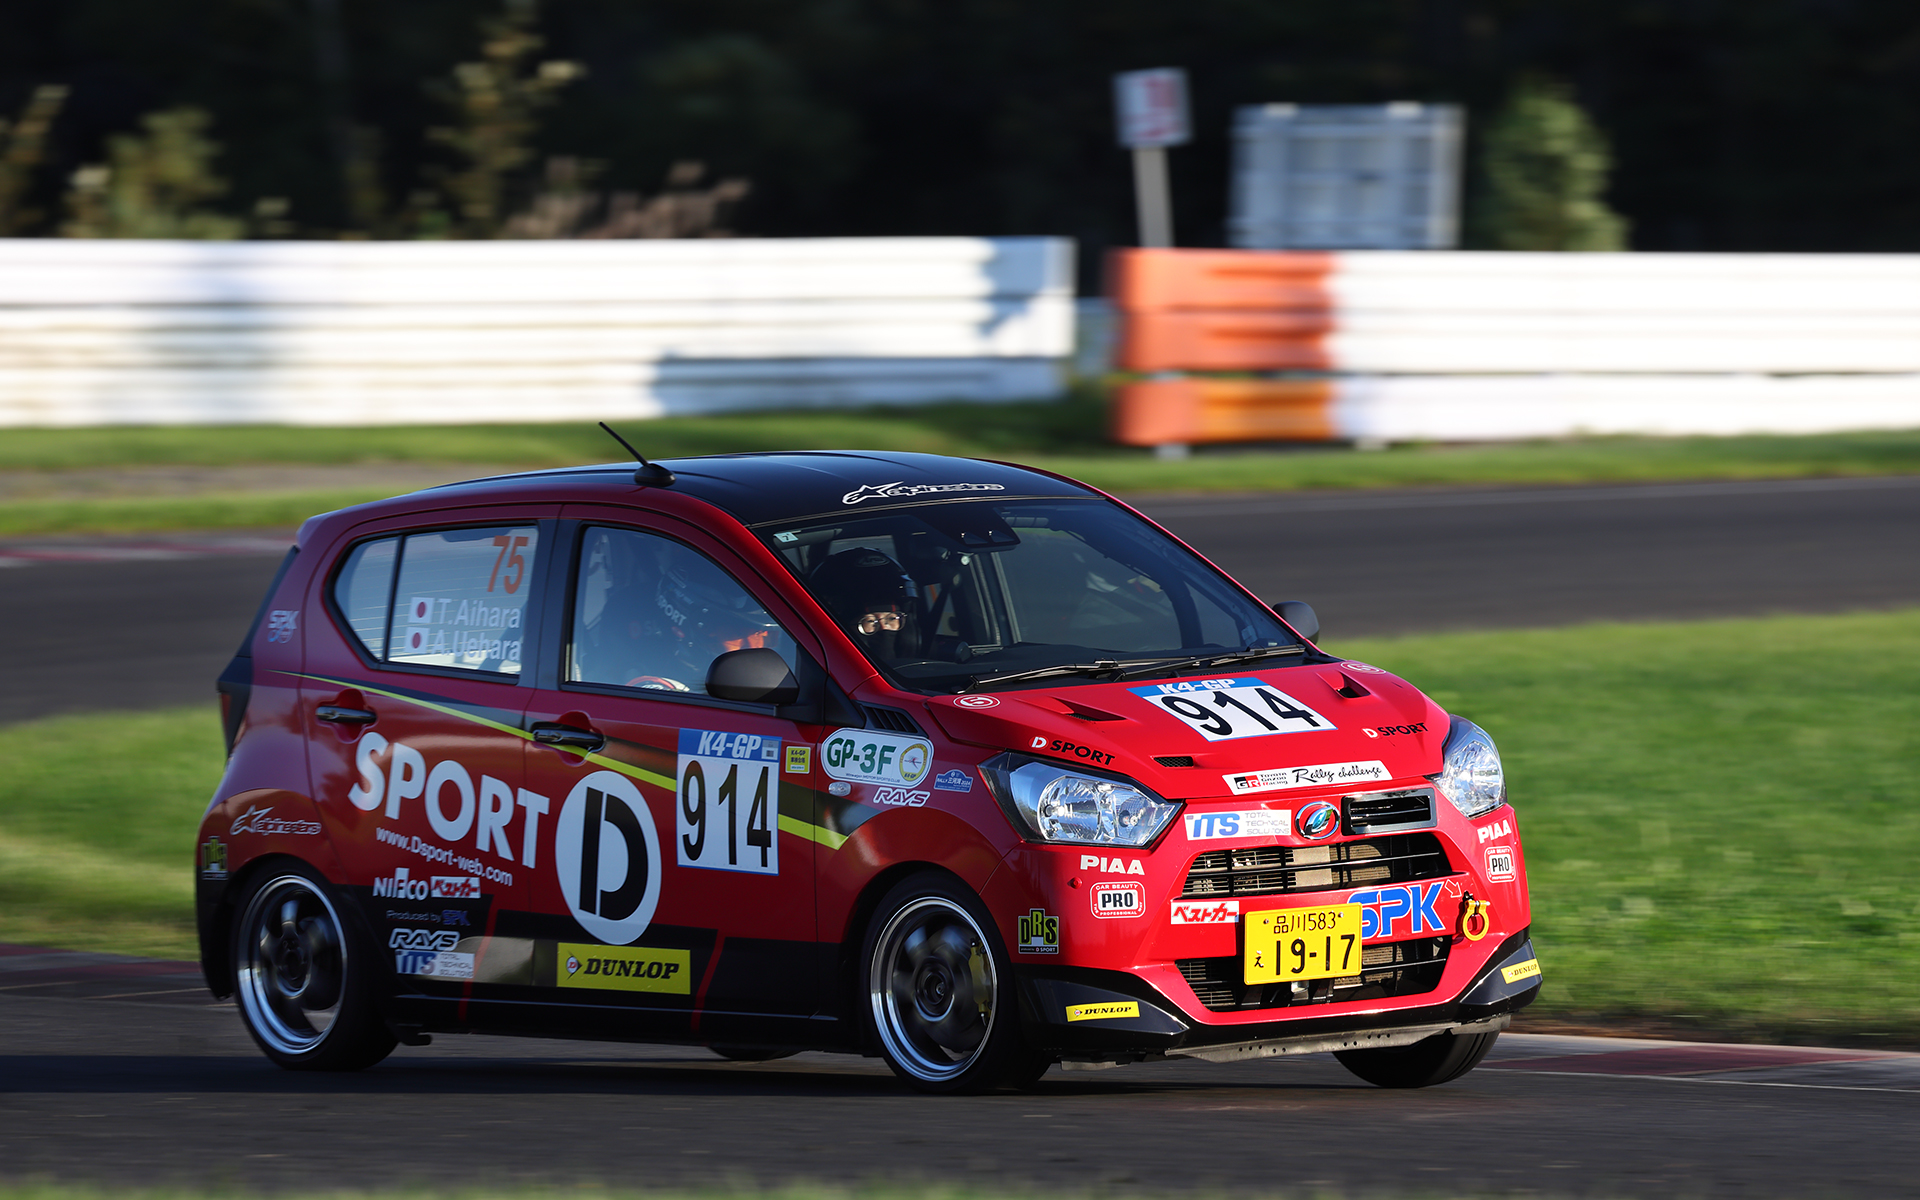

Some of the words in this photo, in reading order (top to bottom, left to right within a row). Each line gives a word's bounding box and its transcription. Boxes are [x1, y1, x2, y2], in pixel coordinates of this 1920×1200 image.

[487, 535, 530, 594] 75
[438, 598, 521, 628] T.Aihara
[432, 629, 521, 660] A.Uehara
[1157, 678, 1236, 694] K4-GP
[1161, 688, 1321, 736] 914
[1377, 722, 1428, 736] SPORT
[697, 731, 762, 759] K4-GP
[827, 737, 897, 775] GP-3F
[1050, 740, 1116, 766] SPORT
[1292, 768, 1335, 783] Rally
[1338, 765, 1383, 778] challenge
[873, 787, 931, 807] RAYS
[682, 760, 772, 868] 914
[347, 732, 550, 869] SPORT
[578, 786, 649, 922] D
[1477, 819, 1512, 844] PIAA
[376, 827, 513, 887] www.Dsport-web.com
[1080, 854, 1145, 876] PIAA
[1492, 857, 1509, 872] PRO
[373, 867, 429, 900] NIFCO
[1101, 892, 1134, 908] PRO
[1172, 902, 1238, 923] ベストカー
[1348, 881, 1446, 940] SPK
[1021, 911, 1057, 943] DRS
[1274, 910, 1336, 934] 品川583
[389, 928, 460, 951] RAYS
[1254, 950, 1265, 968] え
[1275, 934, 1356, 975] 19-17
[584, 957, 680, 980] DUNLOP
[1513, 964, 1537, 976] DUNLOP
[1084, 1006, 1132, 1015] DUNLOP
